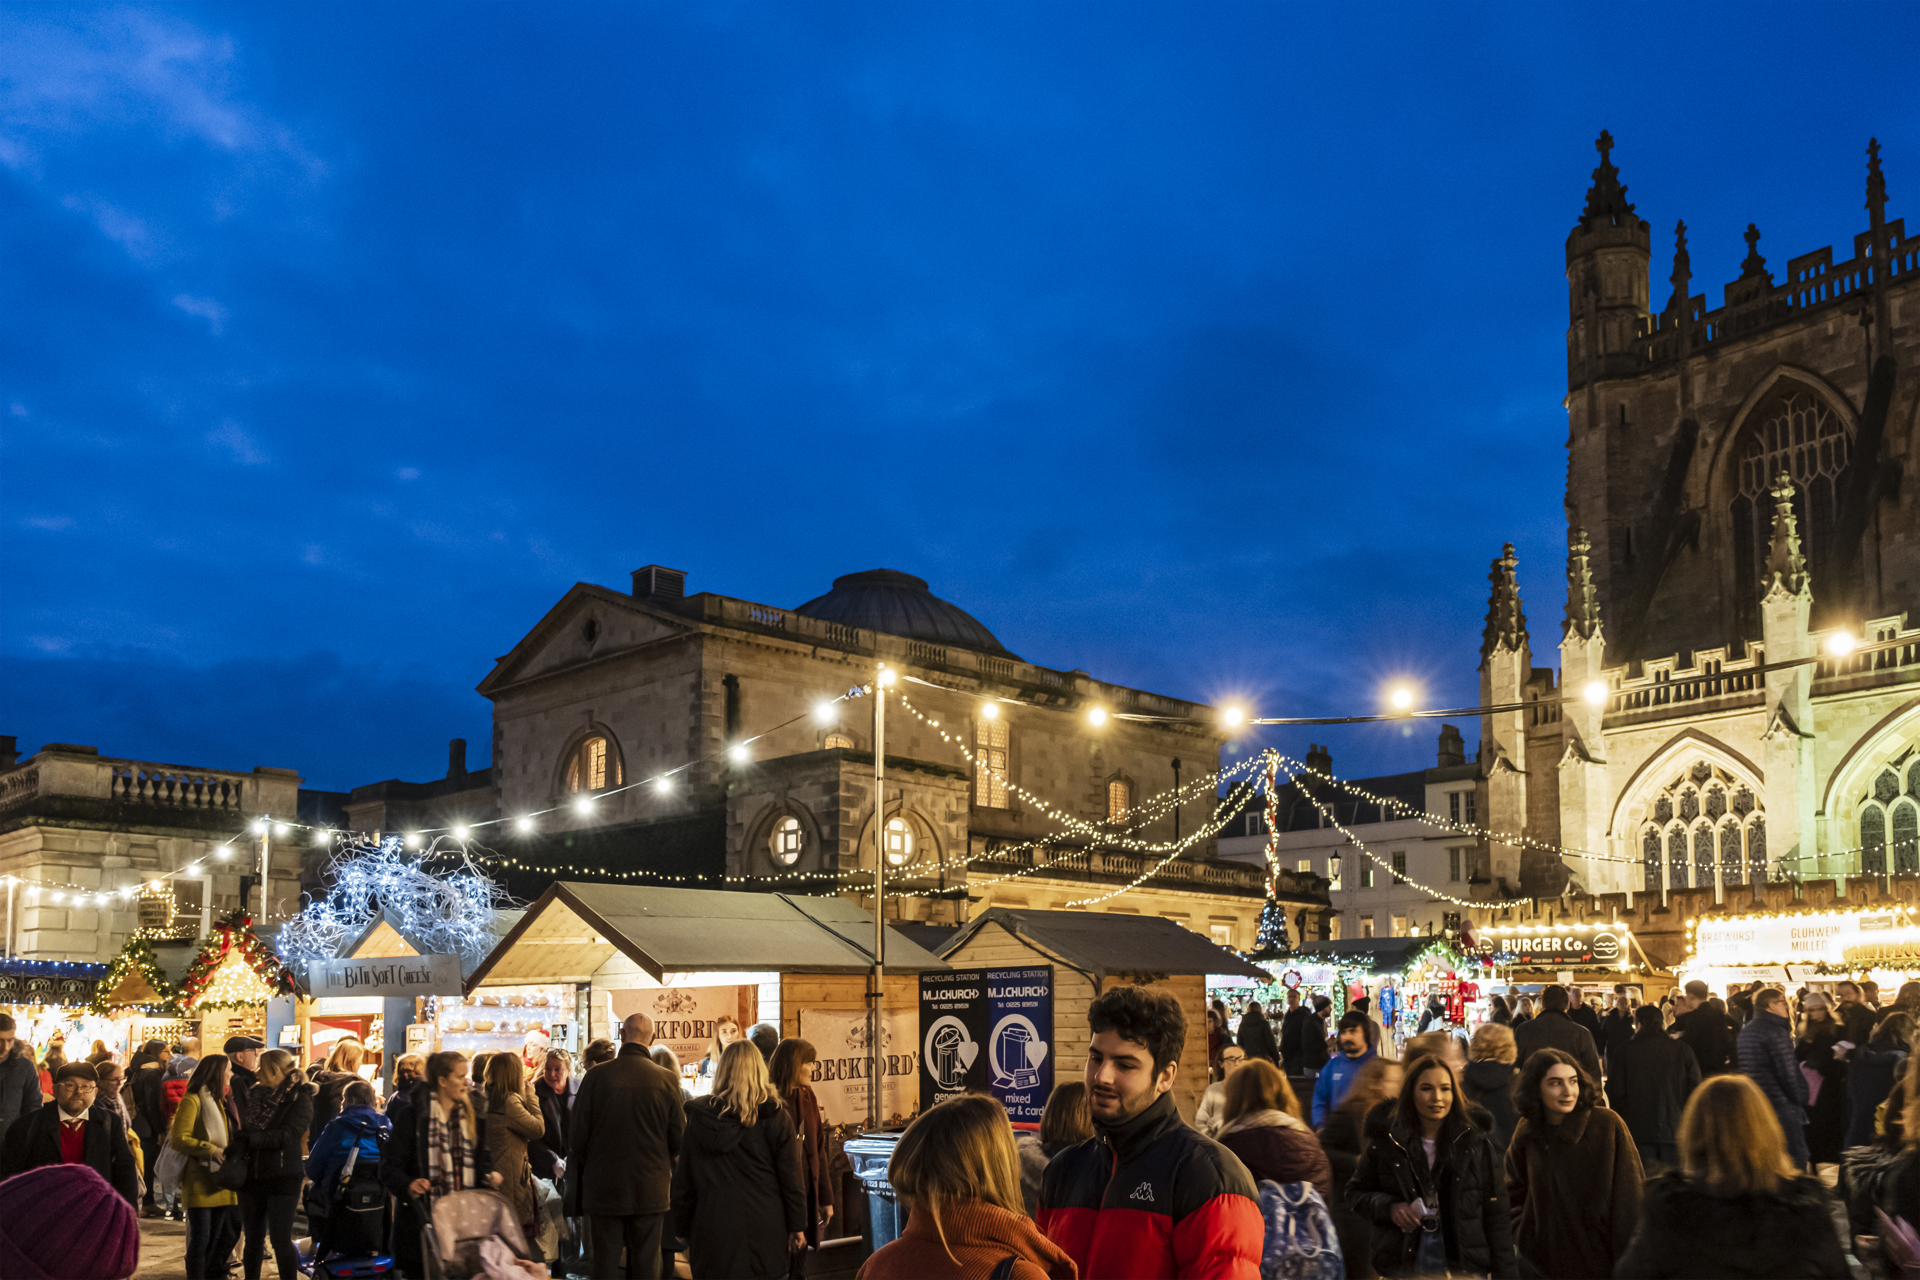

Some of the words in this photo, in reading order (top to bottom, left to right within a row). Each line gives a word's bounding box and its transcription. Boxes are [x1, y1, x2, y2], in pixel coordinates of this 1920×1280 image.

[1701, 930, 1756, 944] BRATWURST
[1501, 937, 1562, 953] BURGER
[1564, 936, 1588, 951] Co.
[1791, 940, 1828, 952] MULLED
[344, 966, 371, 989] BATH
[371, 965, 397, 988] SOFT
[398, 963, 432, 987] CHEESE
[956, 973, 980, 981] STATION
[987, 971, 1020, 979] RECYCLING
[1022, 970, 1048, 979] STATION
[1005, 1093, 1031, 1104] mixed
[1017, 1105, 1023, 1115] &
